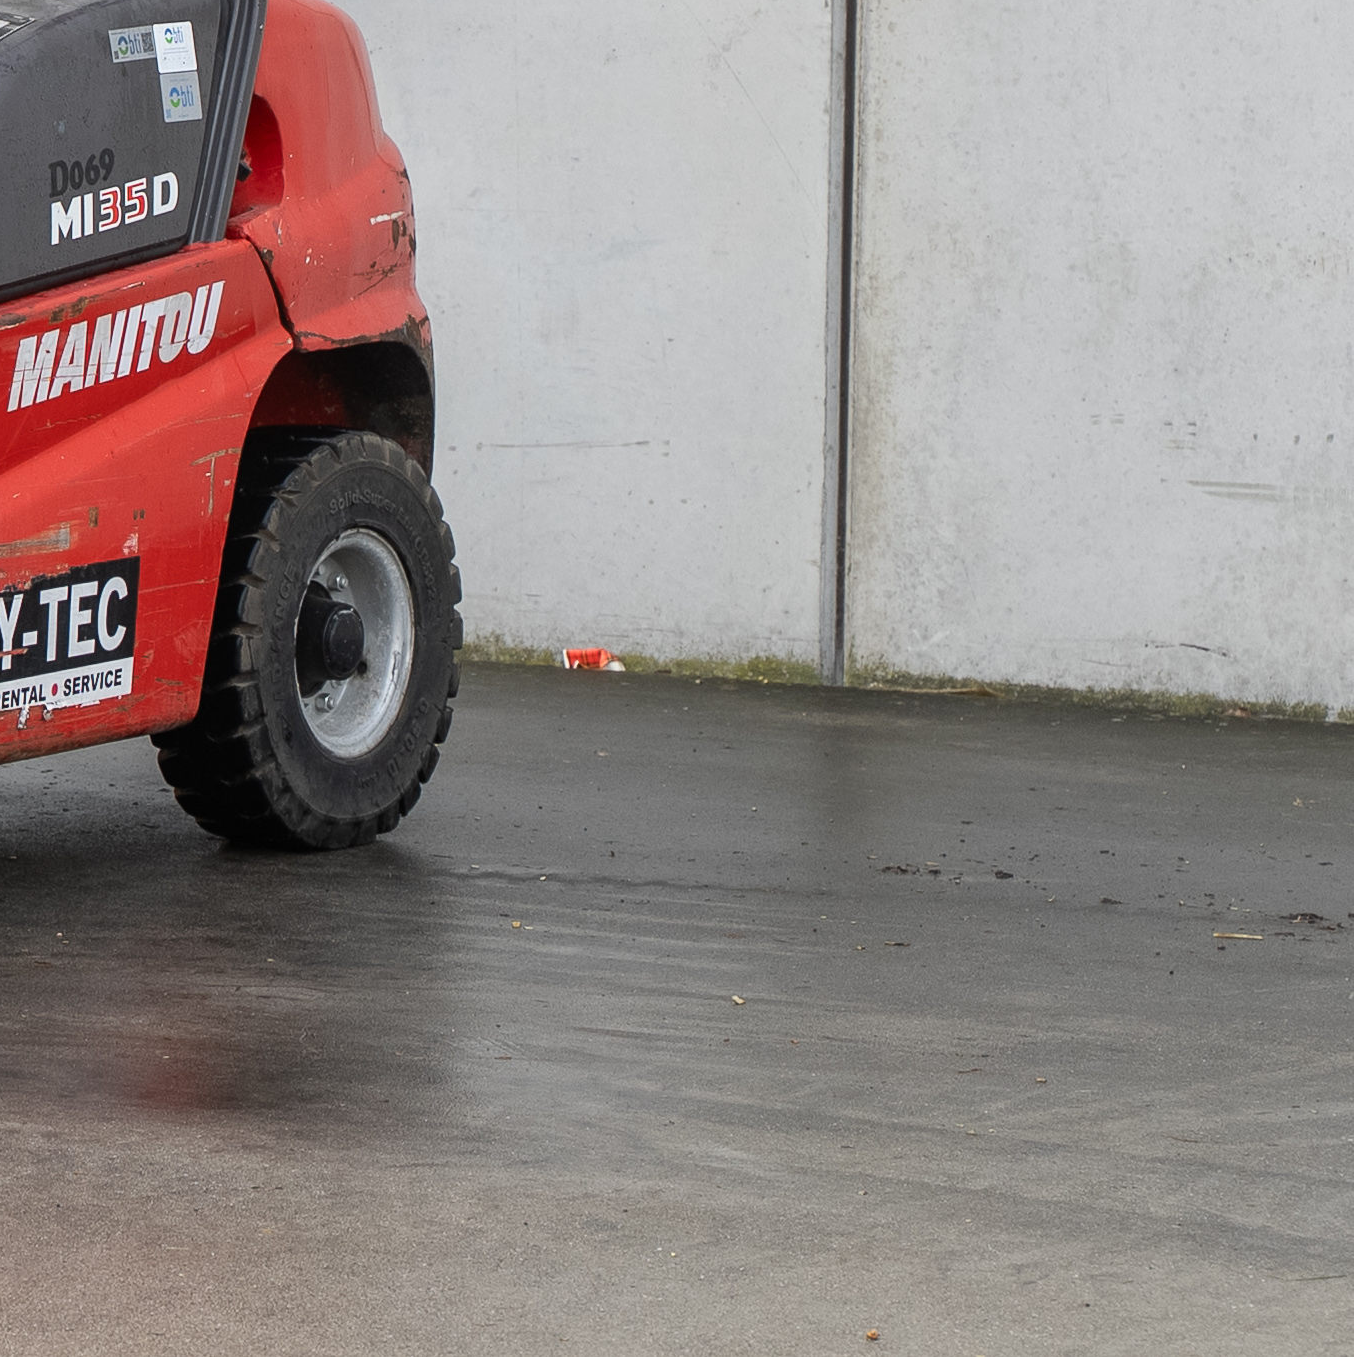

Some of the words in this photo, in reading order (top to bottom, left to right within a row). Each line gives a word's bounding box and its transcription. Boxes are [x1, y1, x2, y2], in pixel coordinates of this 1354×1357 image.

[49, 147, 115, 198] D069
[6, 280, 226, 412] MANITOU
[63, 668, 123, 697] SERVICE
